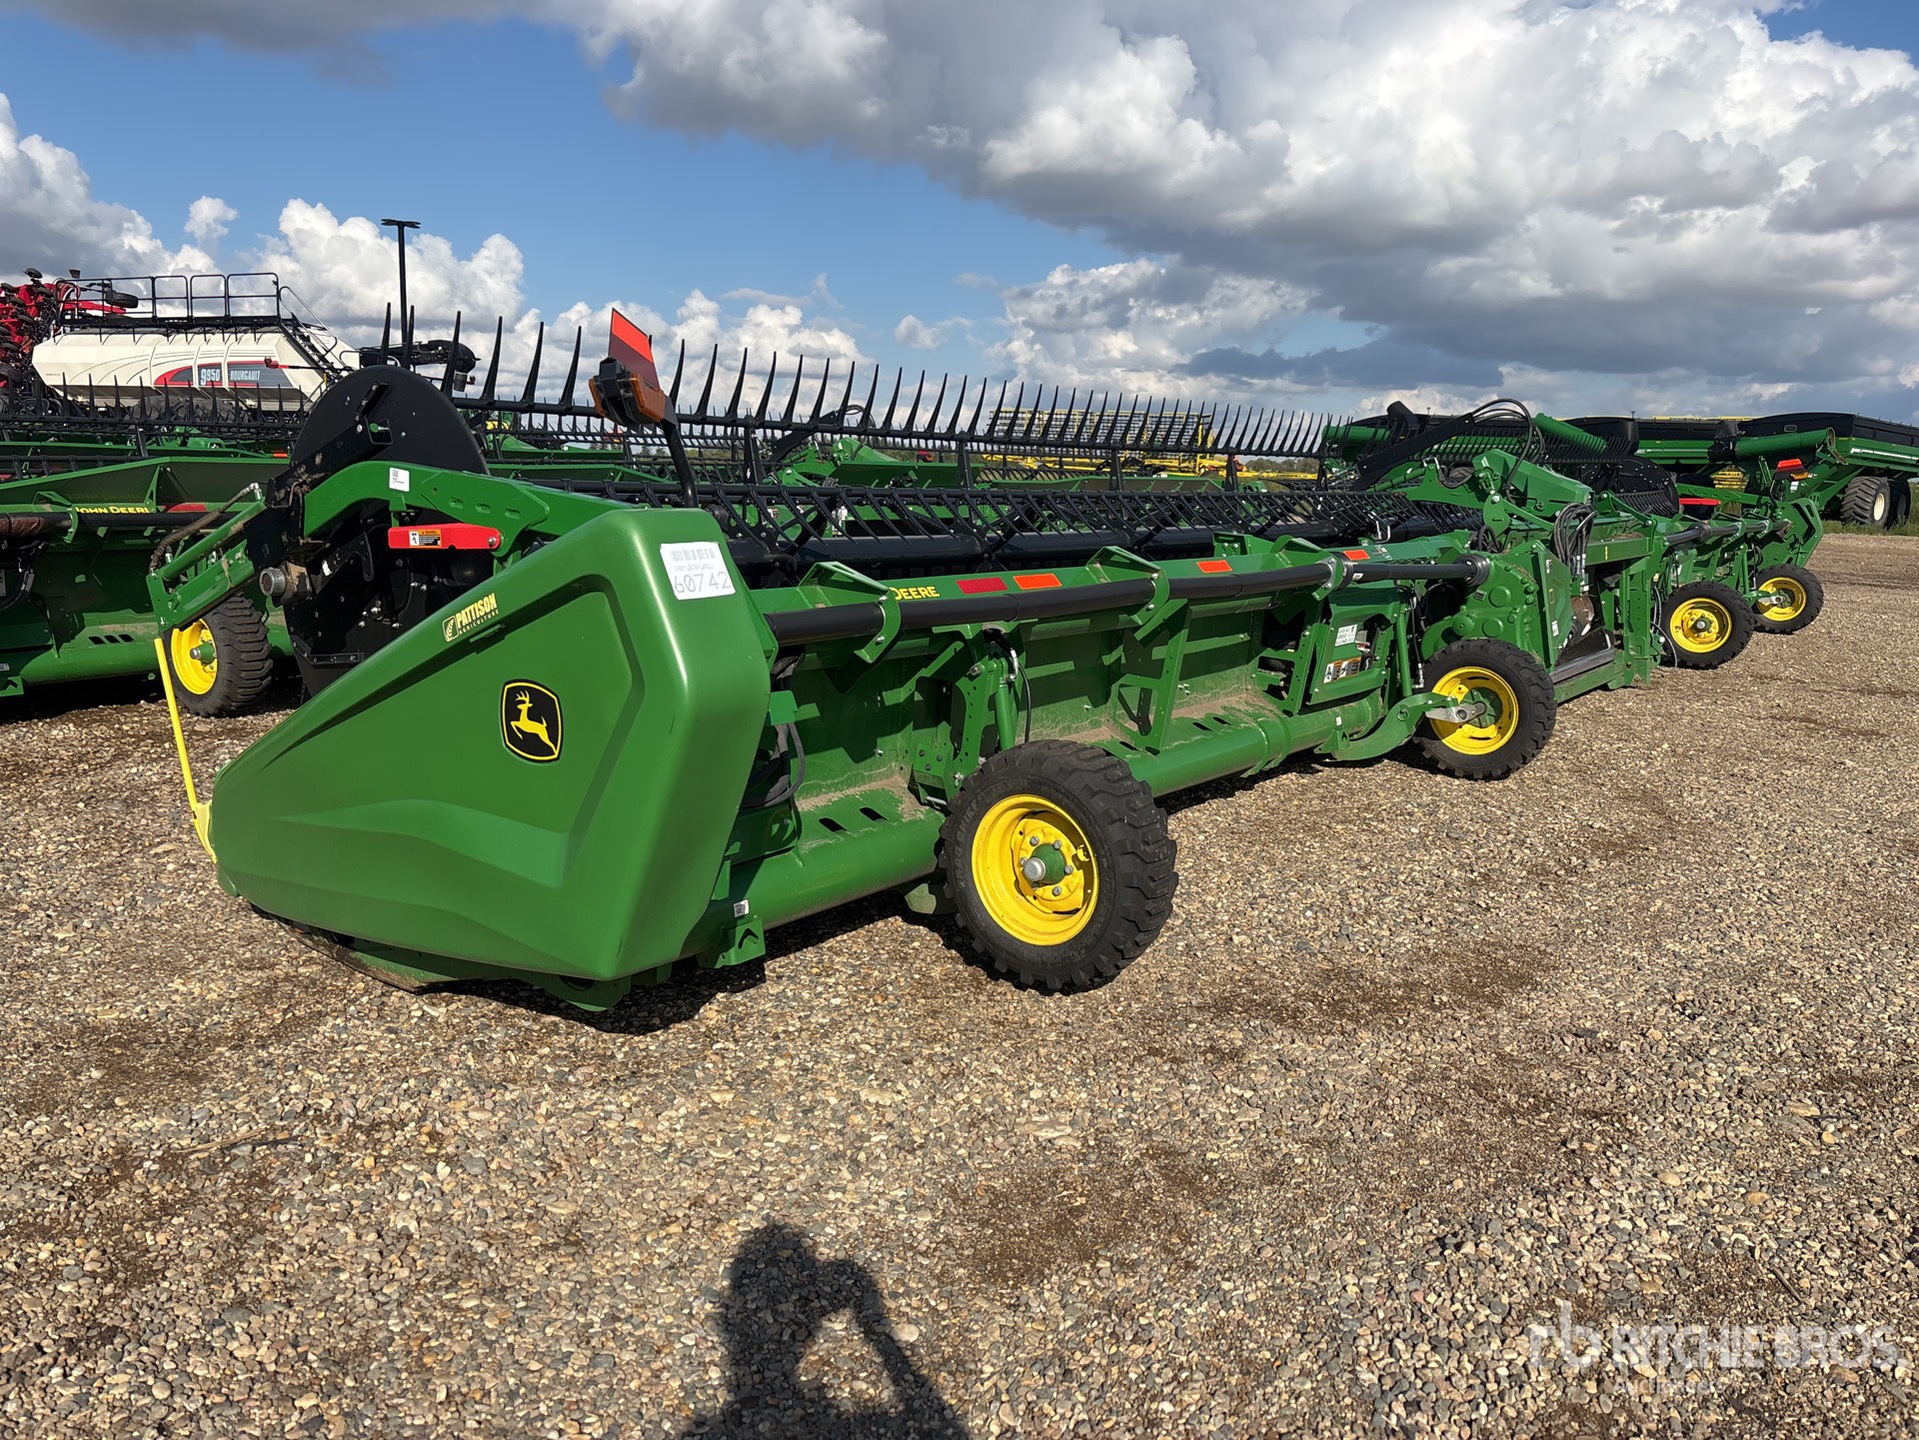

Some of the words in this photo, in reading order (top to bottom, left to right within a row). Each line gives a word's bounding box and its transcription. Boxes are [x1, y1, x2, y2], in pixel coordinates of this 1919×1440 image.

[200, 368, 220, 386] 9950
[230, 370, 261, 381] BOURGAULT
[674, 571, 732, 593] 60742
[455, 592, 498, 629] PATTISON
[459, 609, 499, 635] AGRICULTURE
